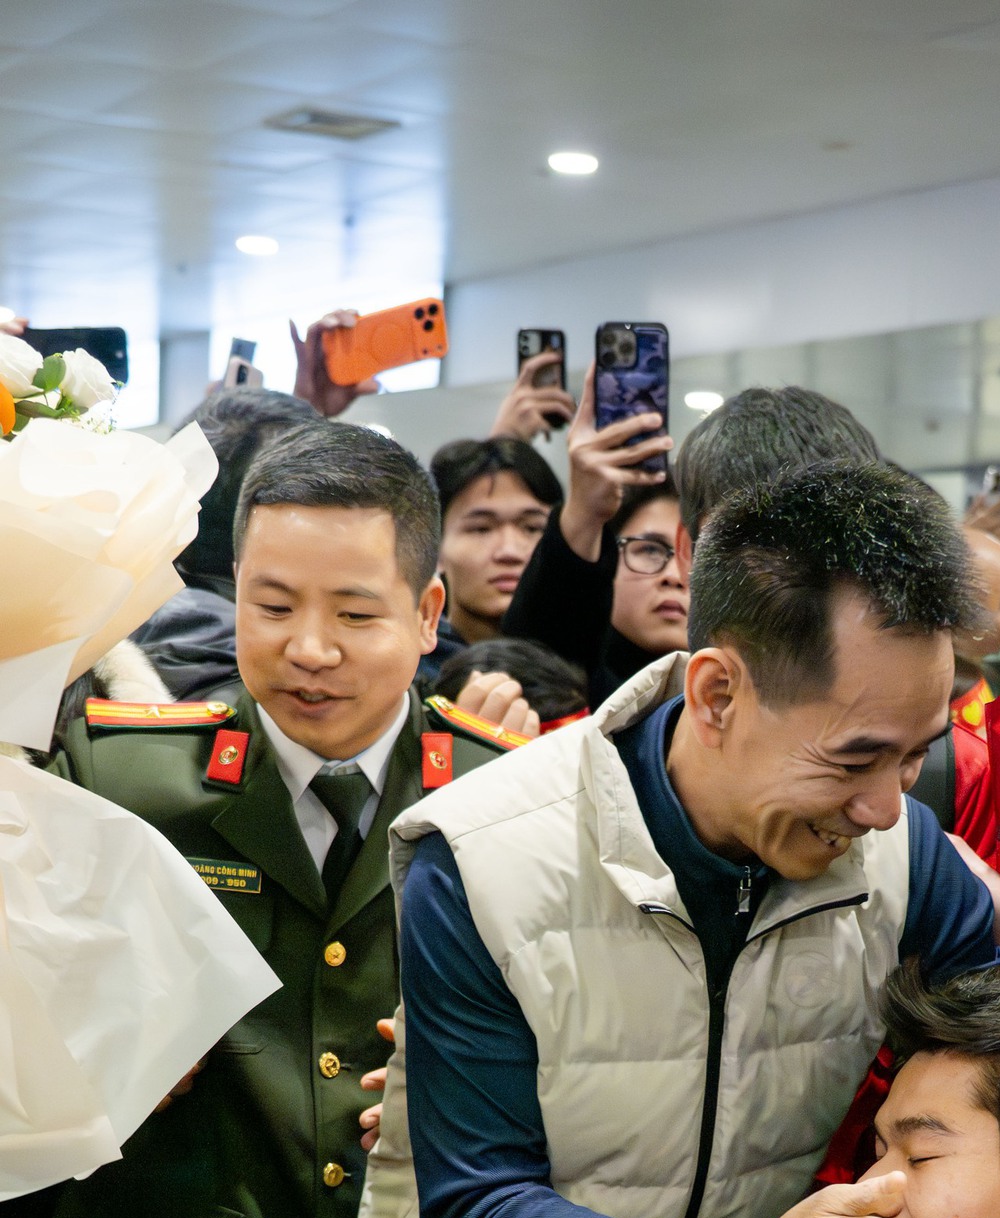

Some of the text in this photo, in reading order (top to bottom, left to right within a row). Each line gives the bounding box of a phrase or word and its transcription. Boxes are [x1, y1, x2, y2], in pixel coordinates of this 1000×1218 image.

[192, 864, 257, 878] OÀNG CÔNG MINH
